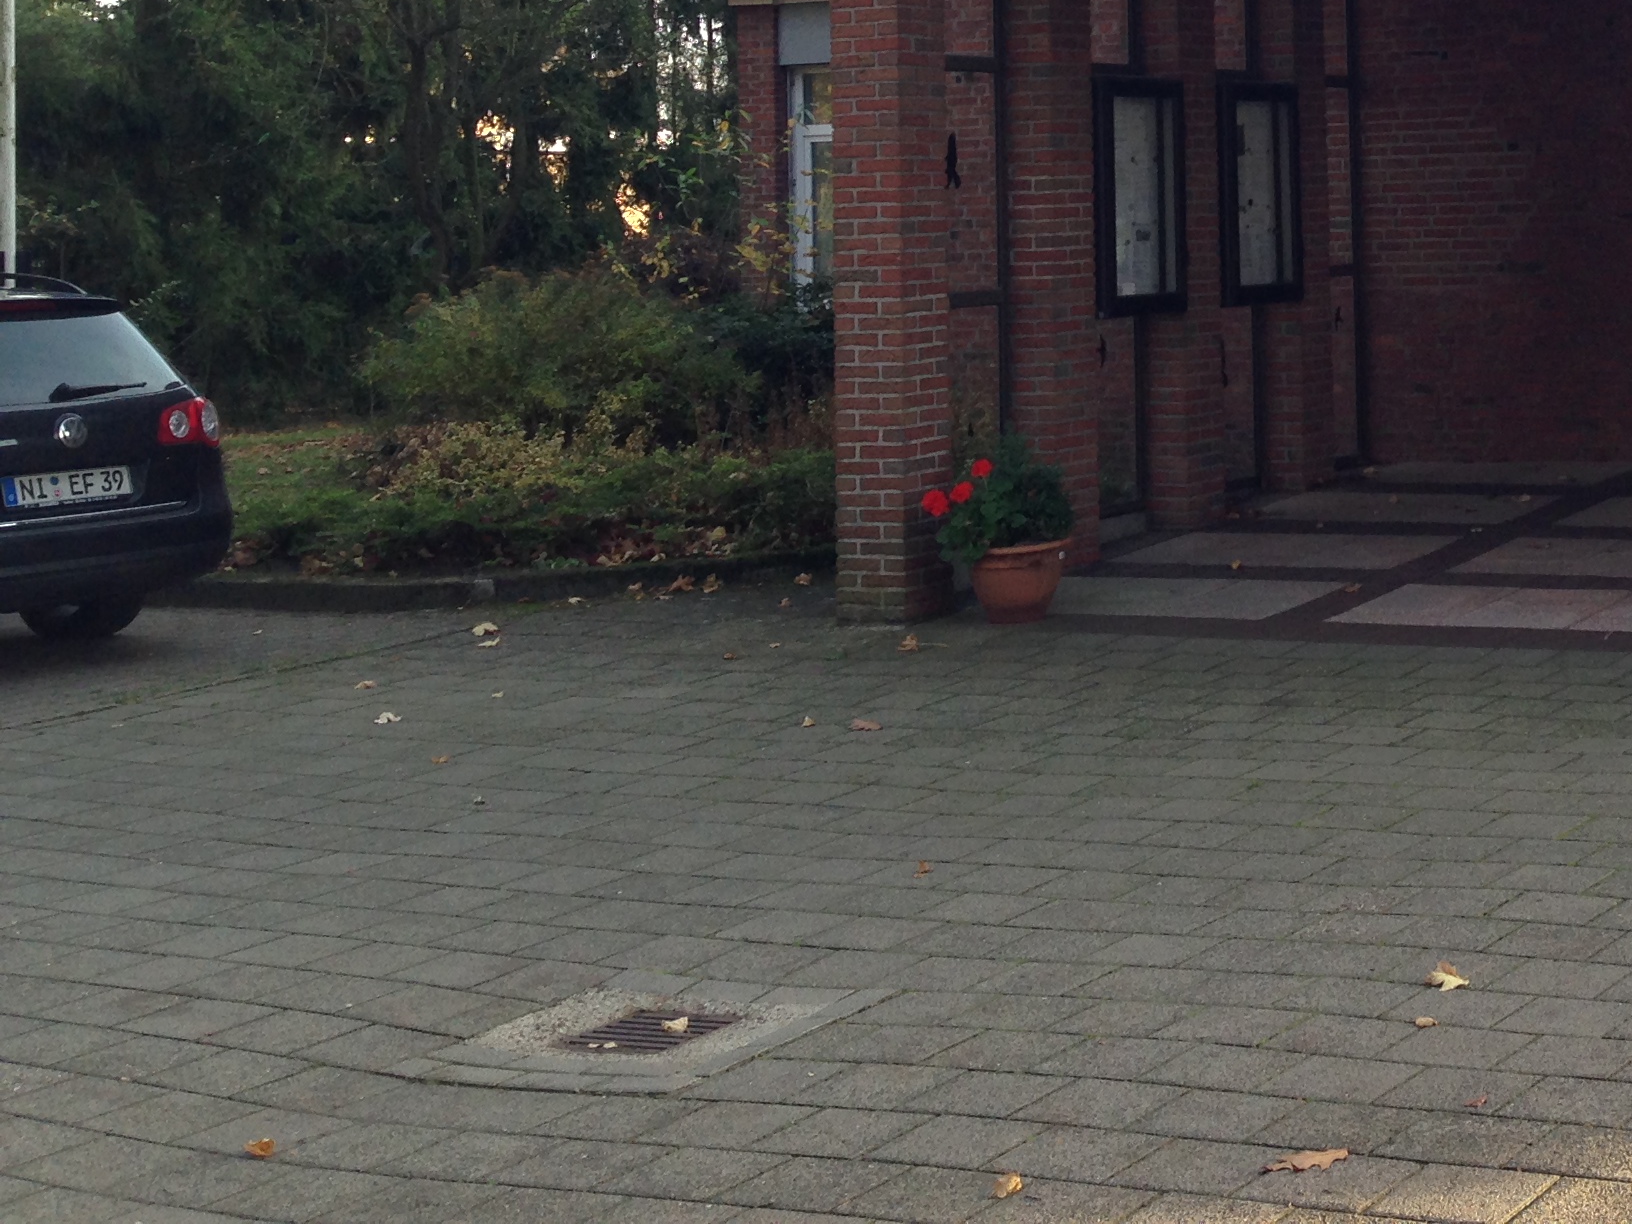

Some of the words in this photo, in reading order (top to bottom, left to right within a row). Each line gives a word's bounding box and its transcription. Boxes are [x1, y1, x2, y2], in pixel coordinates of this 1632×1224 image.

[20, 477, 48, 500] NI
[69, 474, 94, 495] EF
[101, 471, 124, 492] 39
